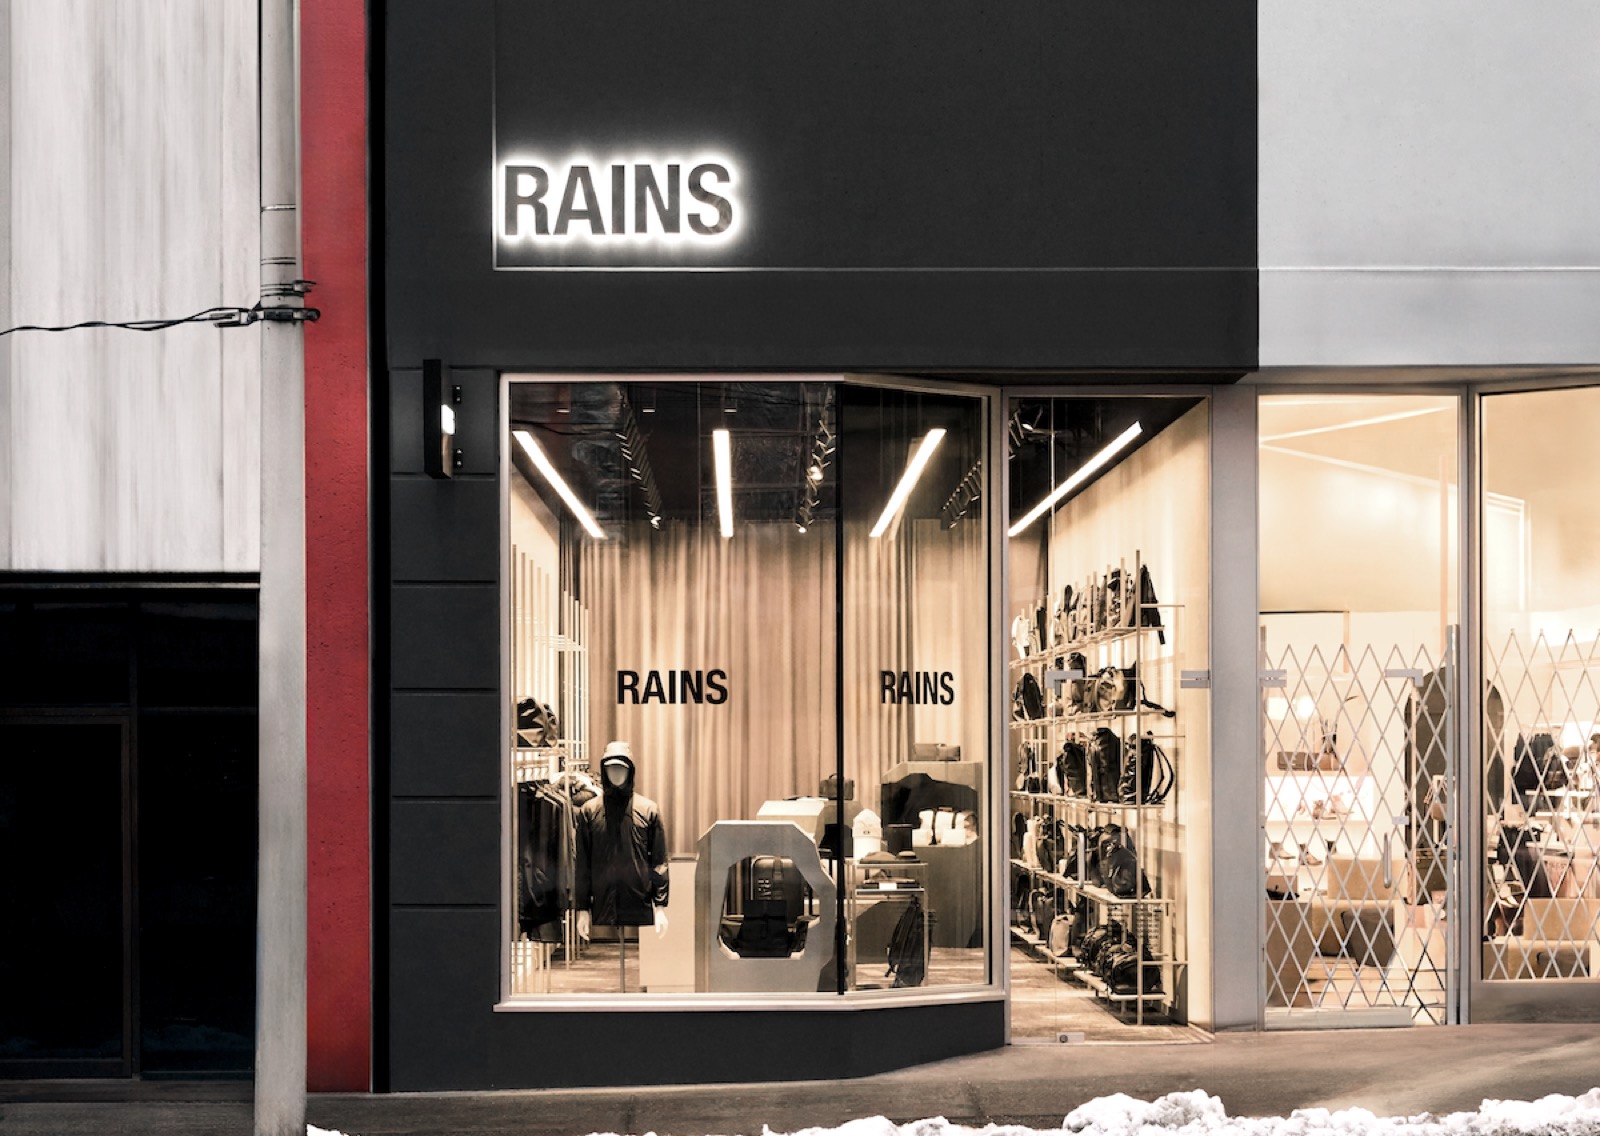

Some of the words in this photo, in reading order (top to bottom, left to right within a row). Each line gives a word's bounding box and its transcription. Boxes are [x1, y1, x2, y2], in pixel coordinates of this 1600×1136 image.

[504, 163, 733, 235] RAINS
[617, 668, 728, 705] RAINS
[880, 670, 955, 705] RAINS
